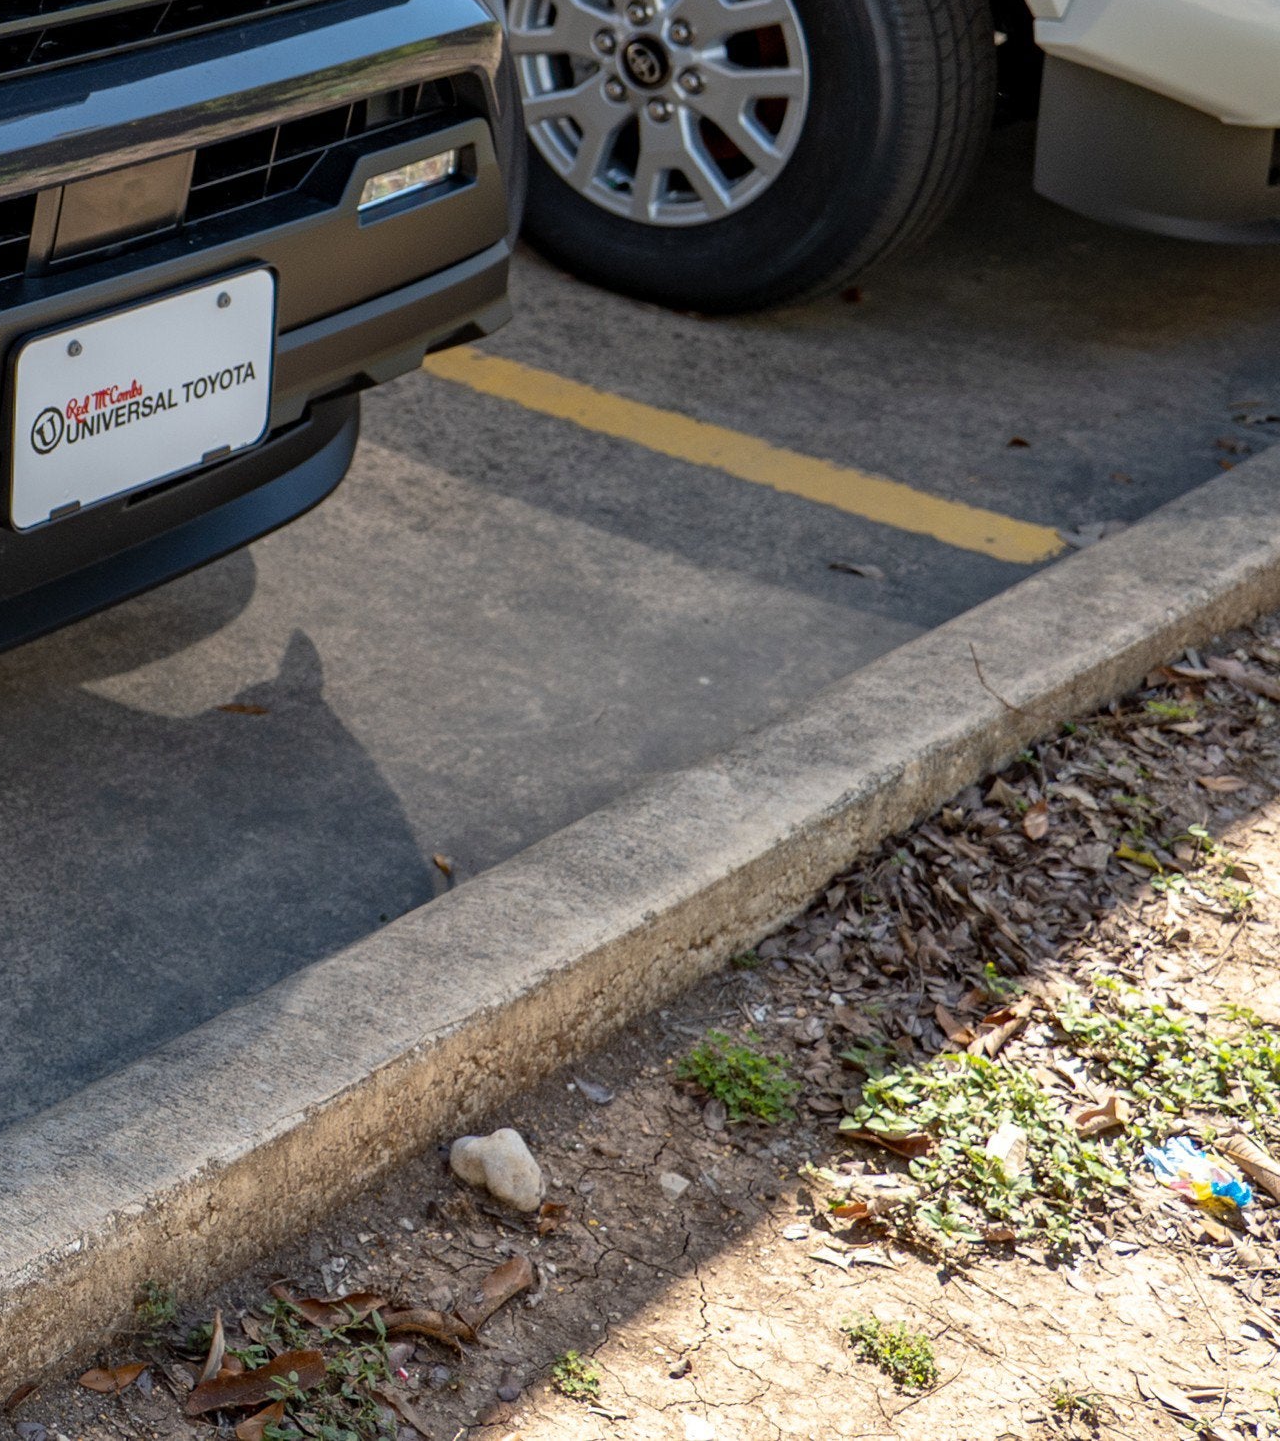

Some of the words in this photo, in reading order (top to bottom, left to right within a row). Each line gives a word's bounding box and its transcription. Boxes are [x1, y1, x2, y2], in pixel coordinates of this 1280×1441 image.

[66, 397, 91, 425] Red
[91, 379, 143, 411] McCombs
[66, 388, 178, 444] UNIVERSAL
[182, 361, 256, 403] TOYOTA
